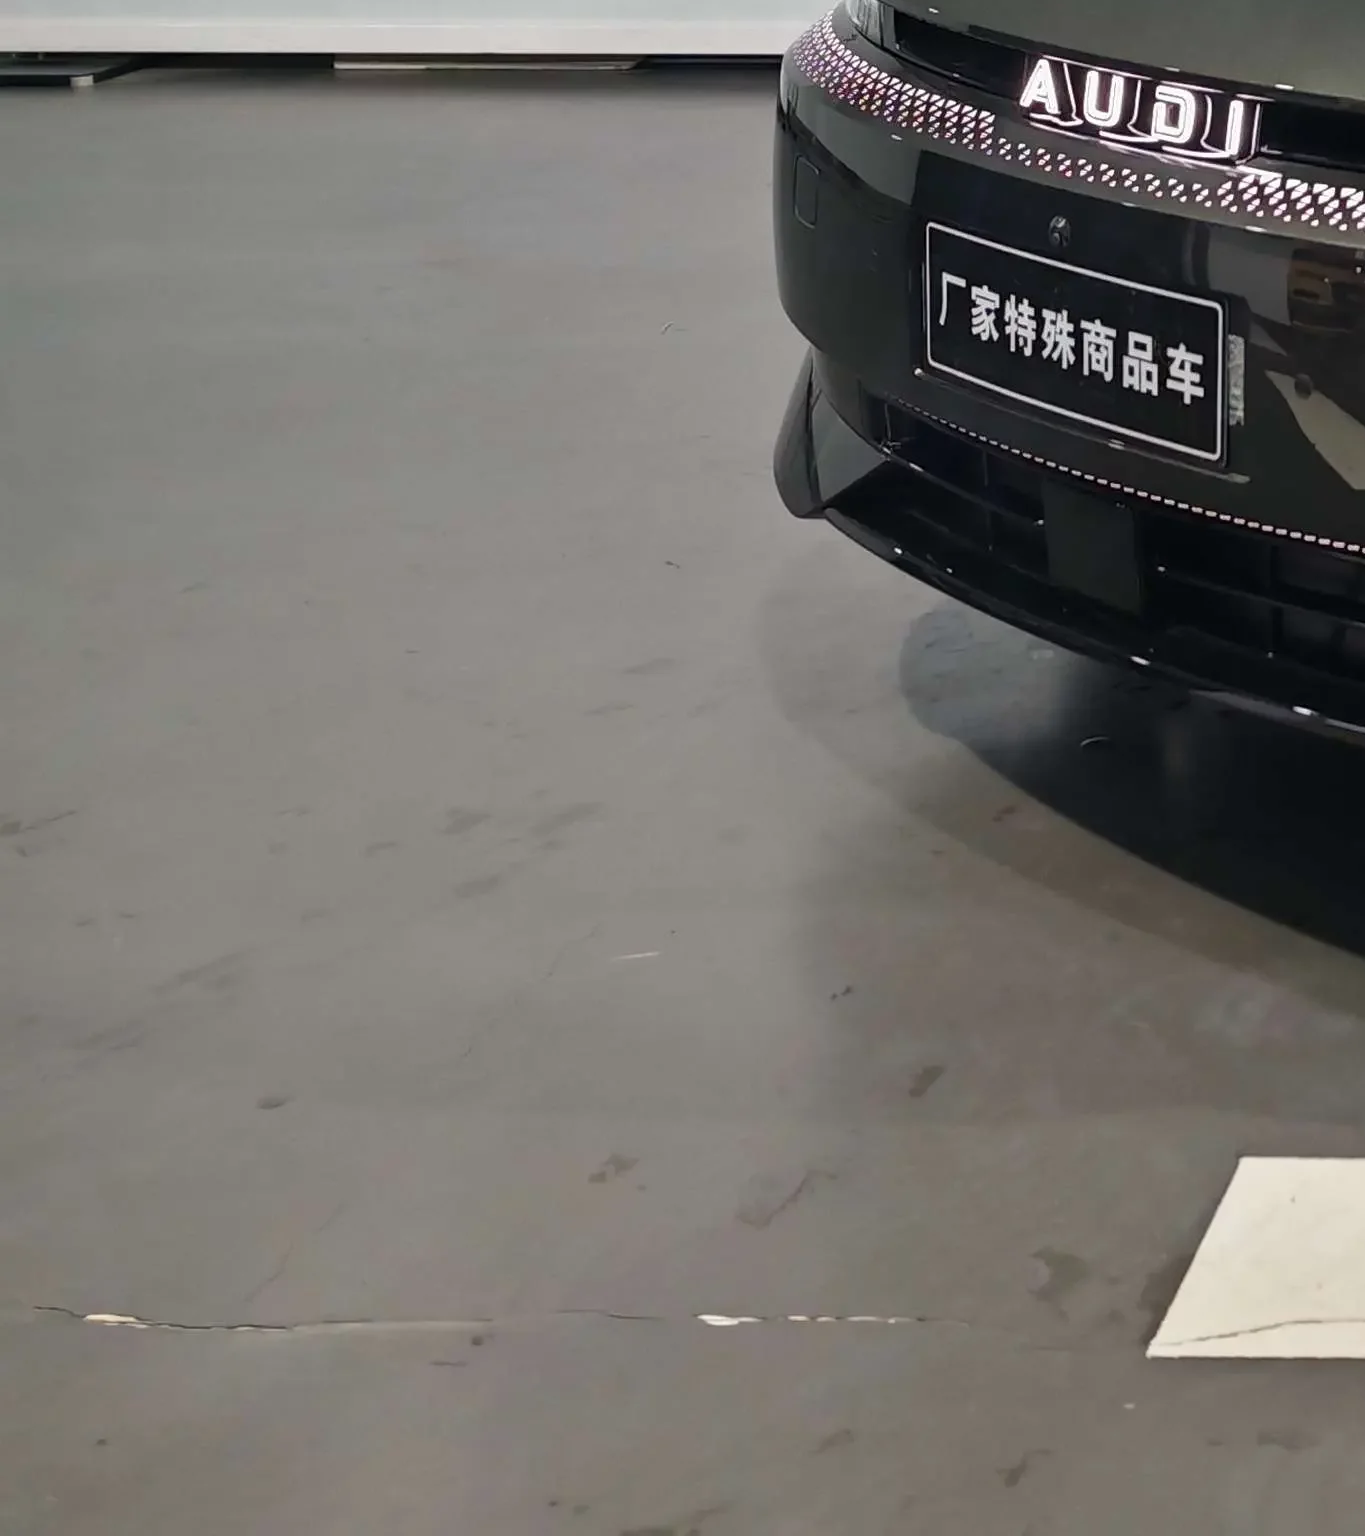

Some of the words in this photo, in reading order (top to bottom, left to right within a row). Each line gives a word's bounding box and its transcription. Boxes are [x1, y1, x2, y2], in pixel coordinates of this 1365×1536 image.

[1018, 57, 1246, 158] AUDI
[938, 270, 1206, 405] 厂家特殊商品车
